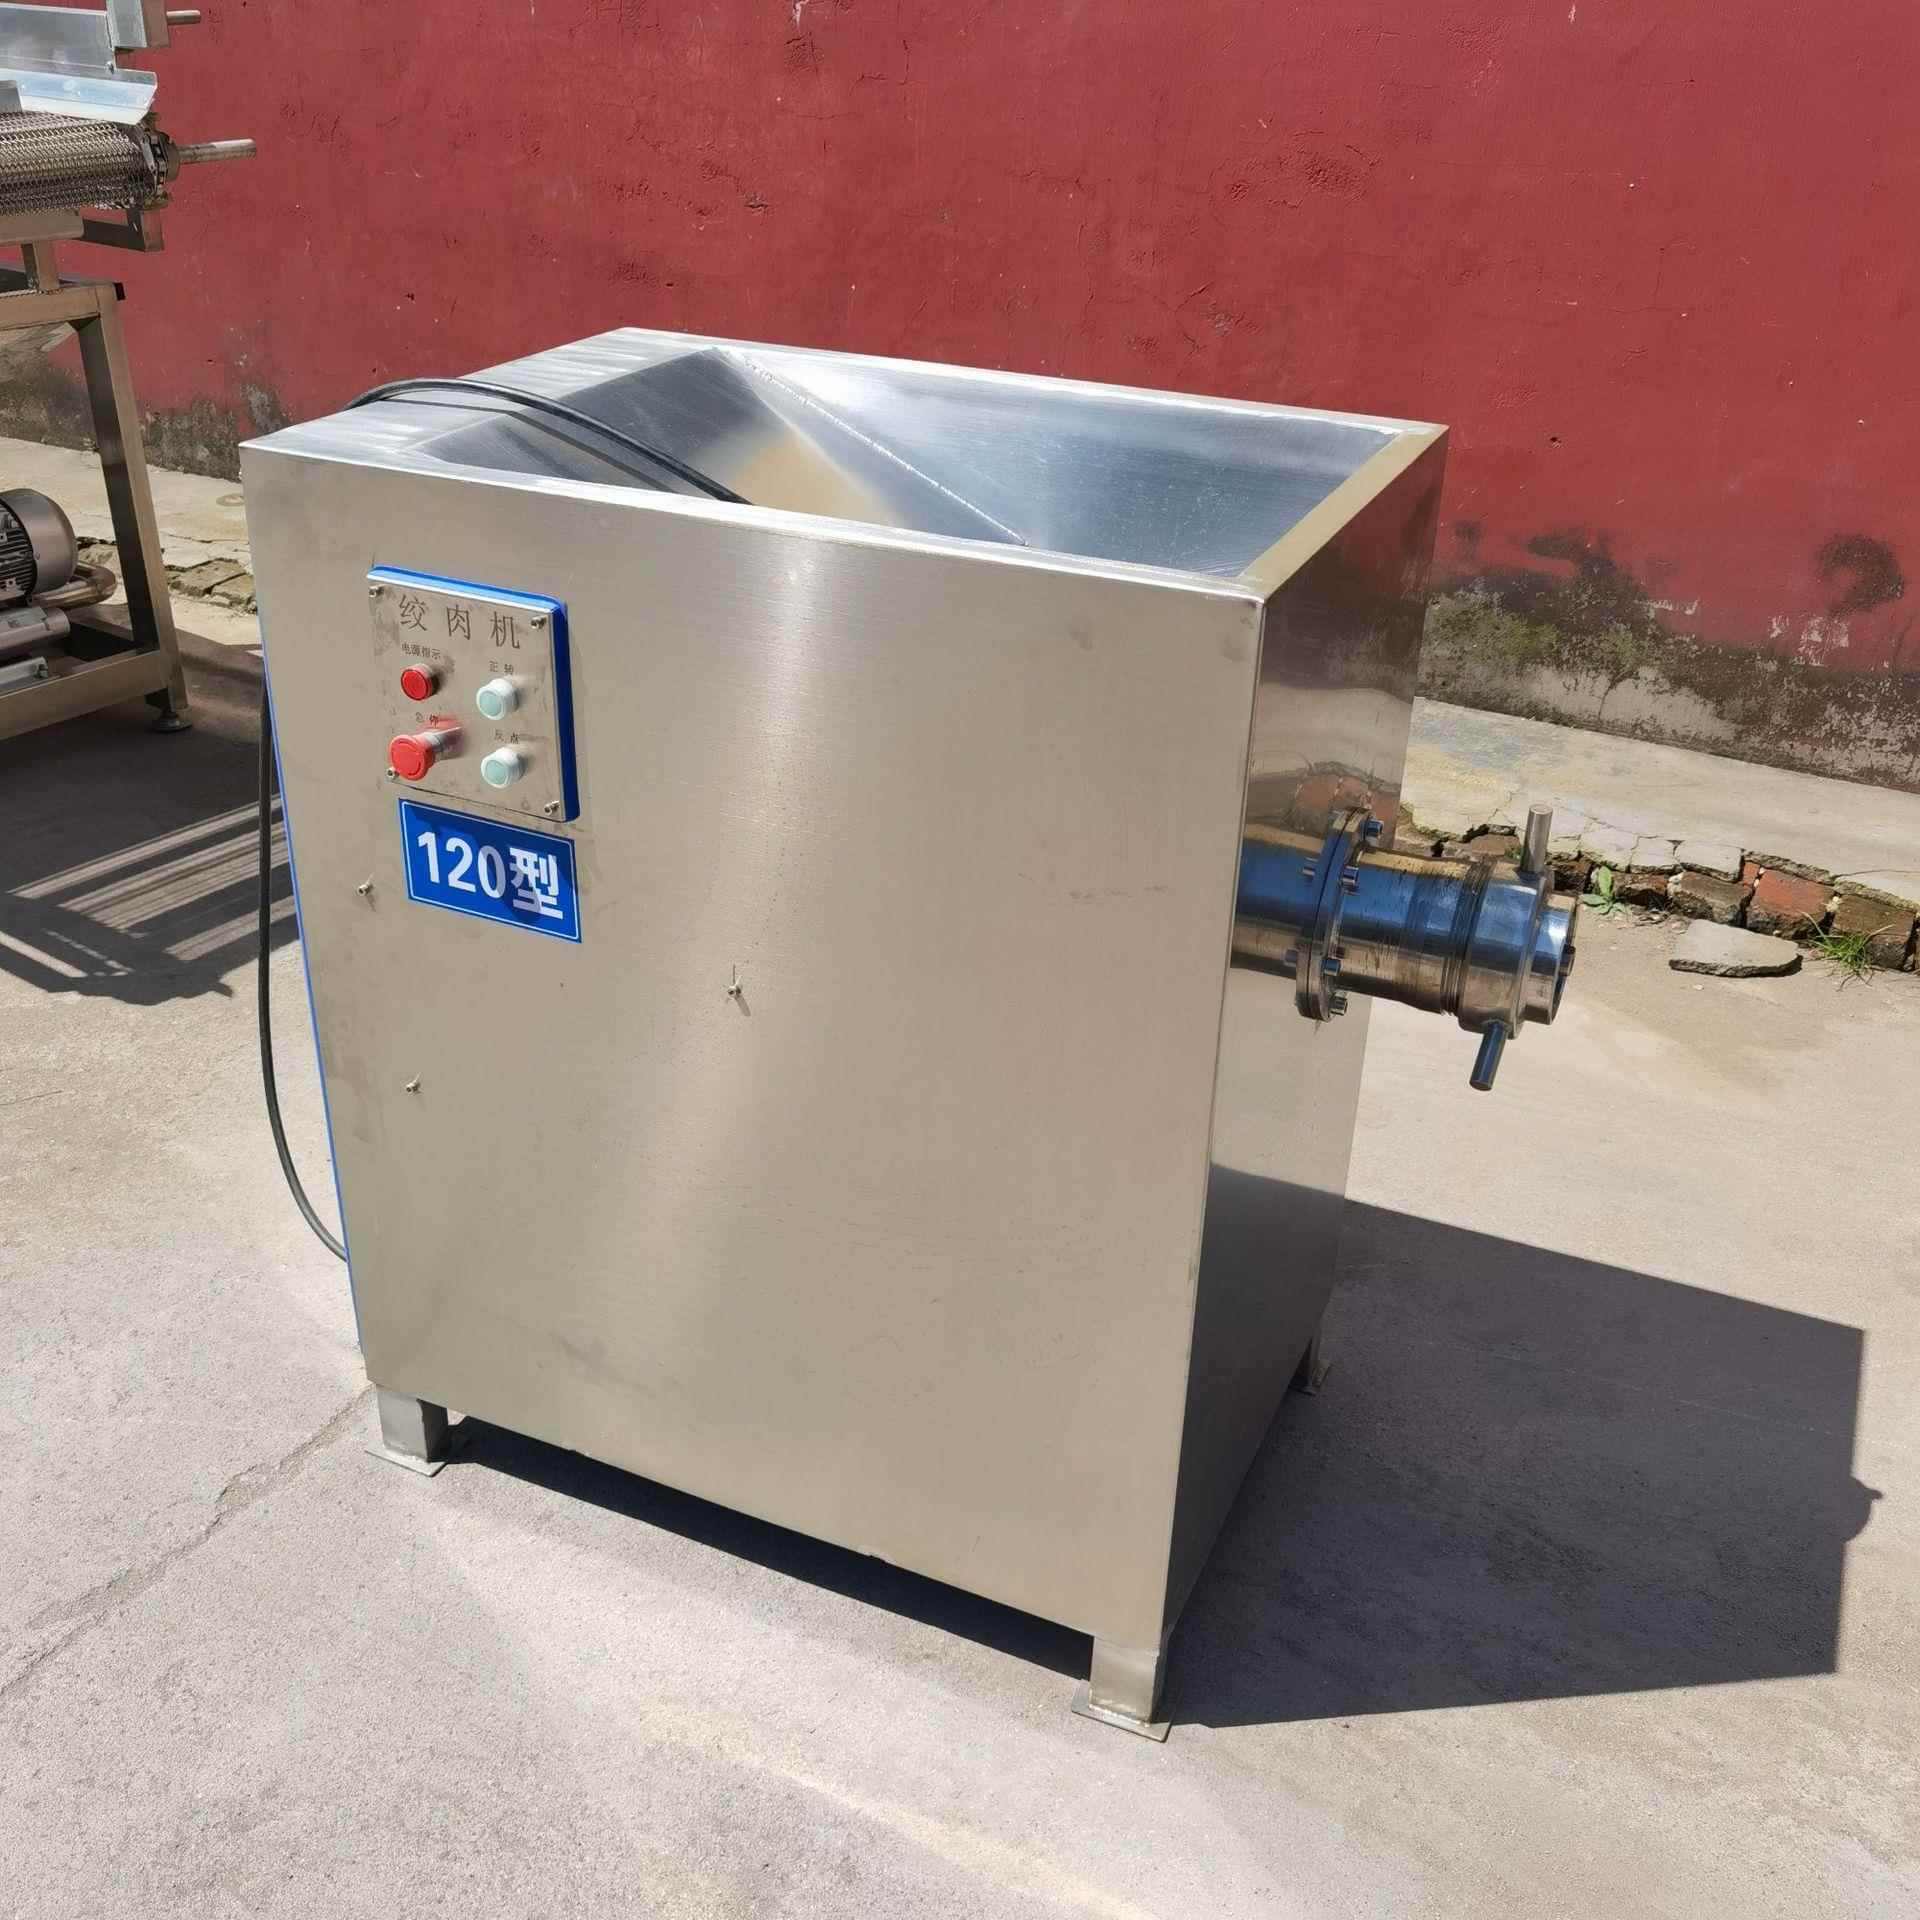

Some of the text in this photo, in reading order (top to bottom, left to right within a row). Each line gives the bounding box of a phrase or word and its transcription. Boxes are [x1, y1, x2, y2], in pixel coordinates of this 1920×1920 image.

[399, 594, 520, 649] 绞肉机
[401, 642, 441, 660] 电源指示
[417, 831, 564, 920] 120型
